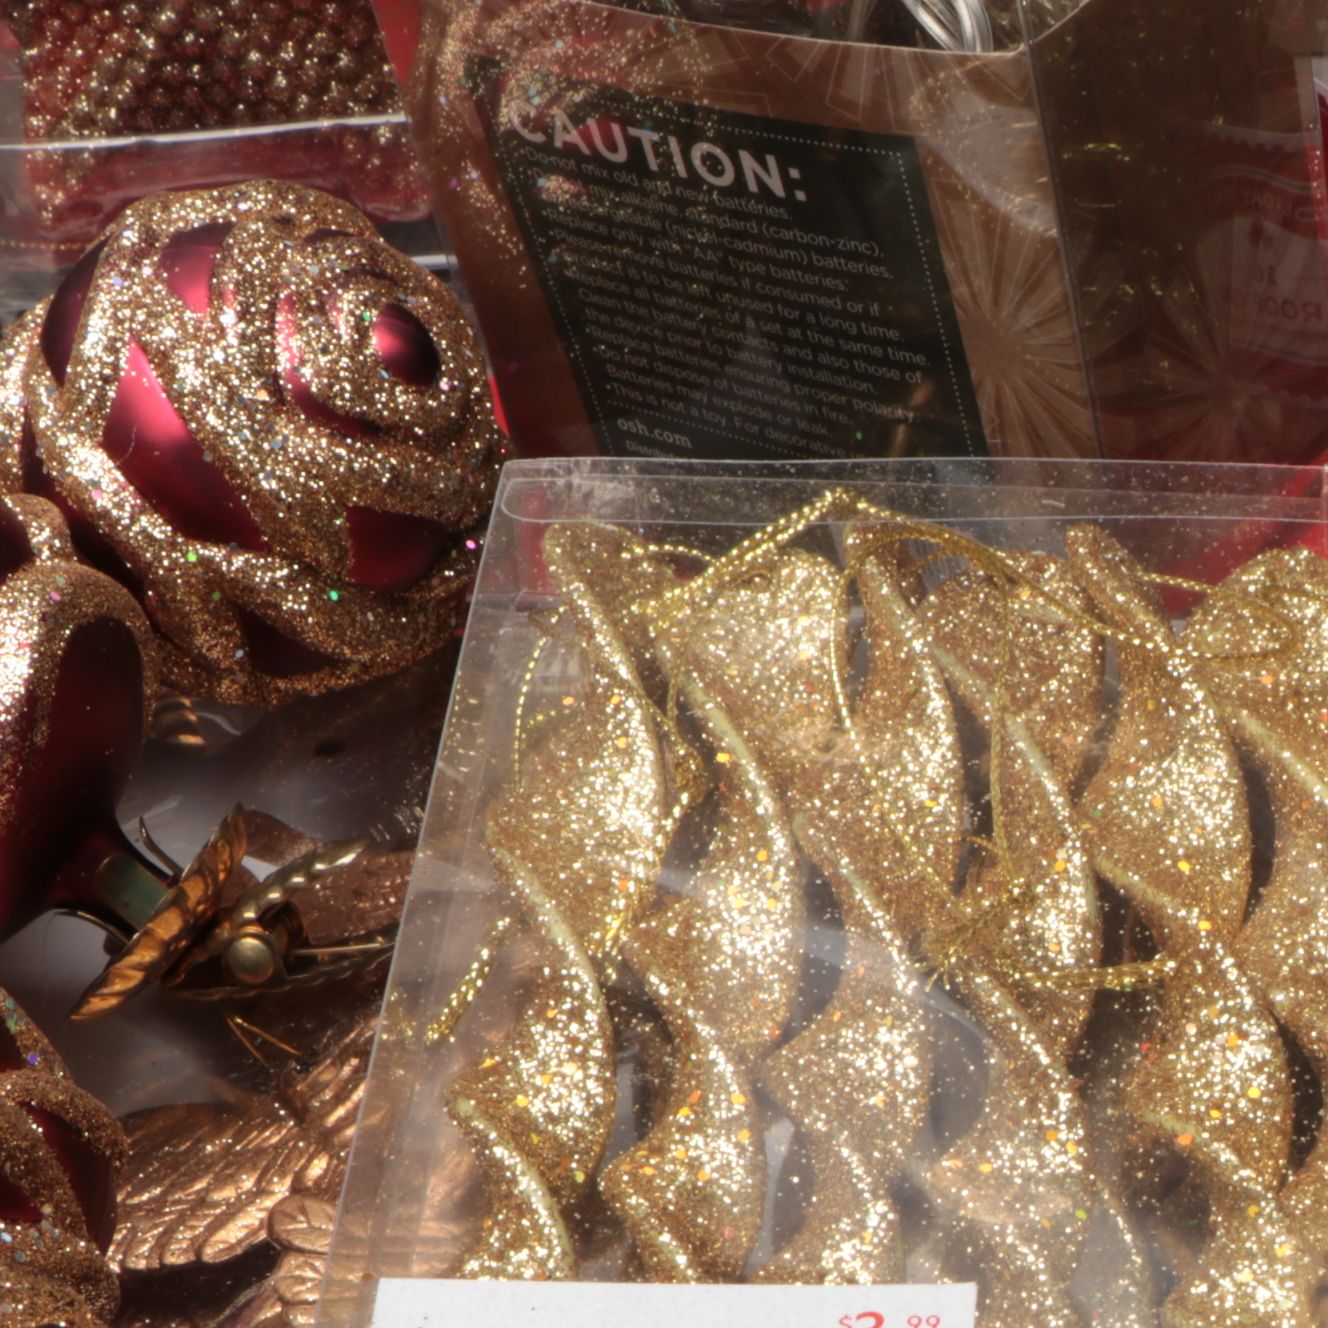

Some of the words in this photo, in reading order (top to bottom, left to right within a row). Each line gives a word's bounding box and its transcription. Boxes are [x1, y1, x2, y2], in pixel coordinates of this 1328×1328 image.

[511, 102, 807, 201] CAUTION:
[582, 163, 608, 179] mix
[613, 169, 639, 187] old
[643, 180, 671, 197] and
[675, 187, 708, 203] new
[713, 191, 793, 221] batteries.
[589, 184, 615, 200] mix
[685, 205, 759, 234] standard
[762, 222, 886, 259] (carbon-zinc),
[547, 208, 608, 235] Replace
[612, 226, 644, 247] only
[648, 236, 683, 255] with
[728, 254, 767, 276] type
[554, 228, 603, 252] Please
[607, 244, 665, 269] remove
[668, 257, 738, 287] batteries
[741, 276, 751, 291] if
[755, 281, 842, 311] consumed
[845, 301, 864, 315] or
[868, 301, 881, 317] if
[811, 252, 894, 280] batteries.
[578, 287, 621, 309] Clean
[623, 299, 649, 317] the
[651, 307, 706, 336] battery
[711, 325, 779, 353] contacts
[783, 343, 814, 362] and
[817, 350, 850, 369] also
[852, 358, 901, 381] those
[904, 370, 923, 386] of
[628, 267, 641, 281] is
[643, 269, 661, 285] to
[663, 273, 685, 290] be
[686, 280, 713, 300] left
[716, 291, 775, 315] unused
[776, 302, 801, 321] for
[805, 312, 817, 325] a
[820, 312, 858, 336] long
[861, 320, 904, 343] time.
[633, 285, 650, 301] all
[652, 290, 721, 320] batteries
[724, 309, 740, 324] of
[744, 315, 756, 329] a
[758, 319, 784, 336] set
[787, 325, 804, 341] at
[806, 330, 836, 348] the
[838, 338, 884, 359] same
[887, 346, 931, 368] time.
[585, 307, 611, 324] the
[613, 314, 664, 338] device
[666, 331, 702, 349] prior
[705, 339, 723, 355] to
[726, 344, 783, 374] battery
[786, 359, 879, 395] installation.
[591, 325, 651, 351] Replace
[653, 342, 721, 372] batteries
[723, 363, 791, 393] ensuring
[794, 382, 849, 405] proper
[600, 346, 622, 362] Do
[624, 351, 650, 370] not
[652, 359, 711, 387] dispose
[713, 375, 729, 391] of
[732, 382, 801, 413] batteries
[803, 402, 819, 416] in
[606, 363, 674, 393] Batteries
[676, 383, 709, 405] may
[712, 394, 773, 421] explode
[776, 413, 793, 427] or
[612, 381, 643, 402] This
[646, 393, 659, 407] is
[661, 398, 688, 416] not
[689, 405, 701, 418] a
[733, 416, 761, 435] For
[764, 427, 847, 459] decorative
[616, 418, 694, 449] osh.com
